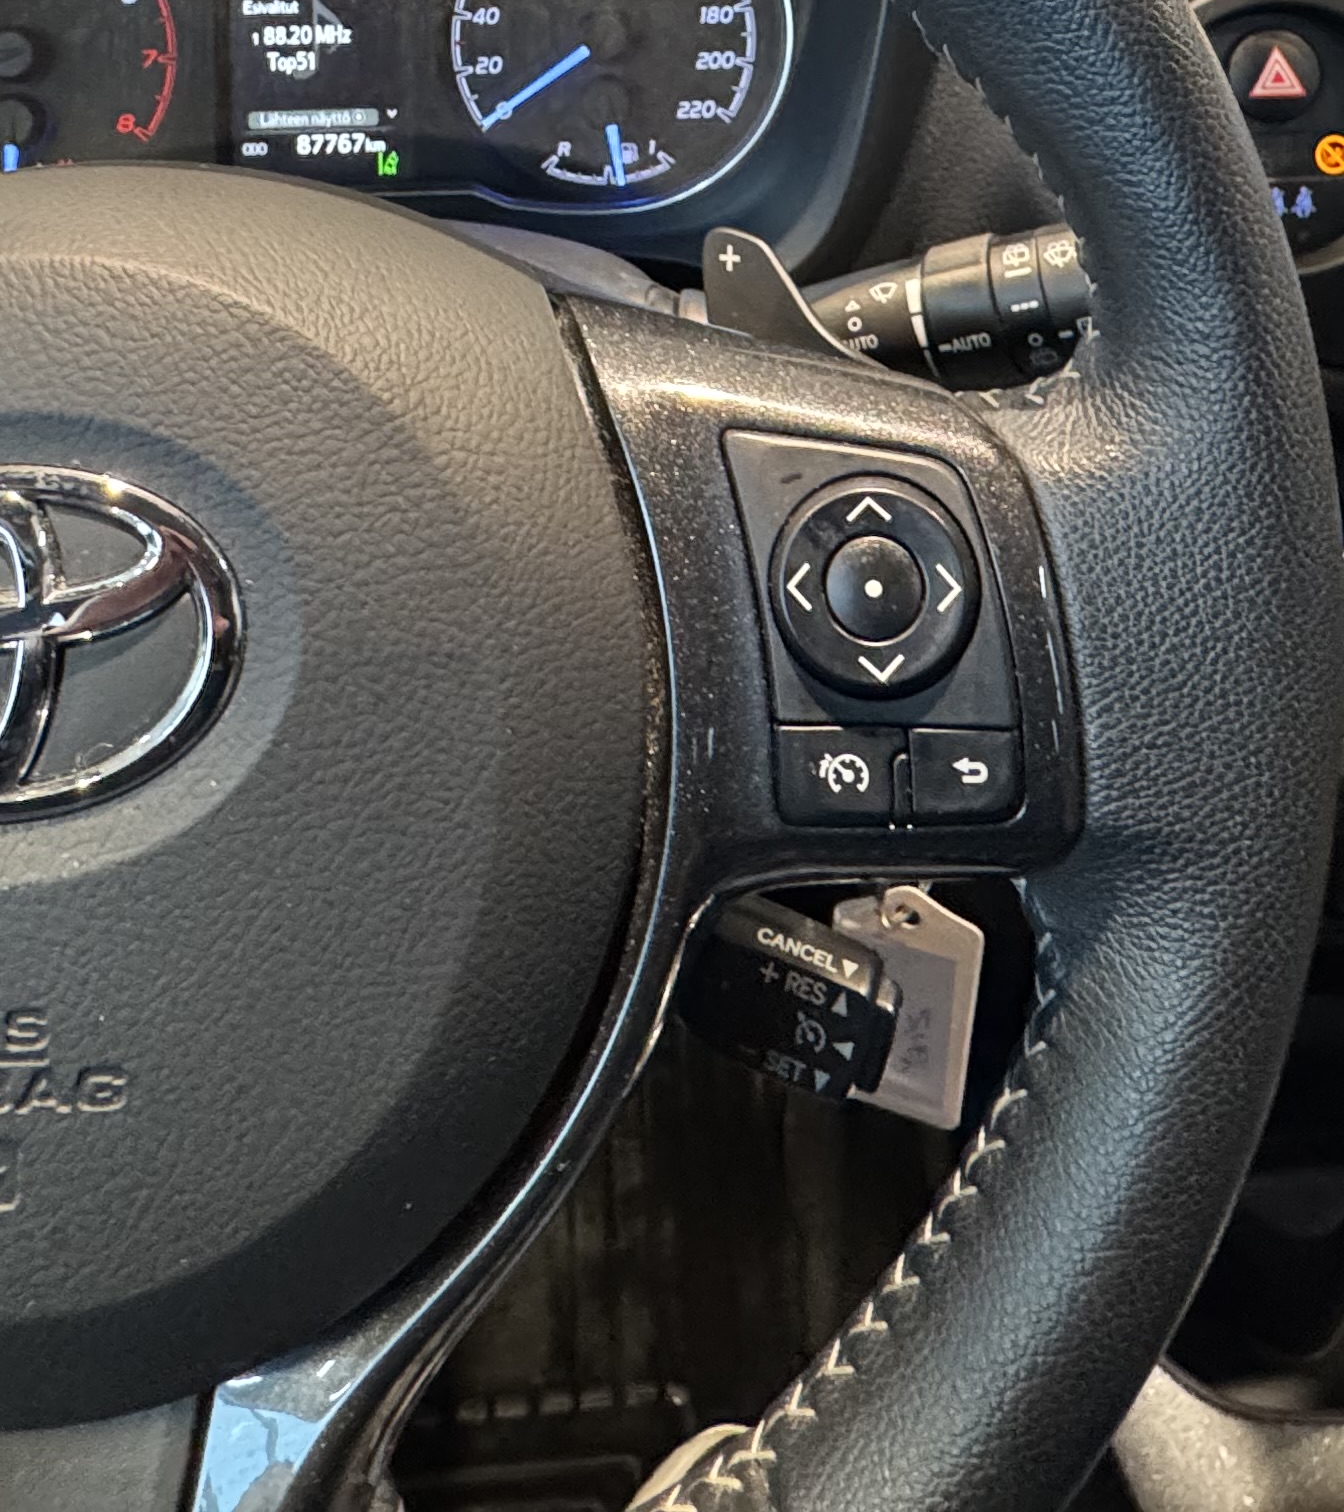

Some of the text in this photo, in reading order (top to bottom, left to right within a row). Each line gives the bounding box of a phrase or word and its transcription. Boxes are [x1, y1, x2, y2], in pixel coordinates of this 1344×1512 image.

[471, 6, 501, 26] 40
[699, 4, 734, 25] 180
[263, 24, 313, 46] 88.20
[315, 23, 353, 45] MHz
[141, 48, 158, 69] 7
[266, 50, 316, 75] Top51
[474, 55, 504, 76] 20
[694, 50, 737, 71] 200
[675, 99, 717, 120] 220
[116, 113, 136, 134] 8
[296, 133, 387, 156] 87767 km
[556, 141, 572, 157] R
[951, 333, 992, 353] AUTO
[757, 927, 838, 974] CANCEL
[785, 970, 827, 1006] RES
